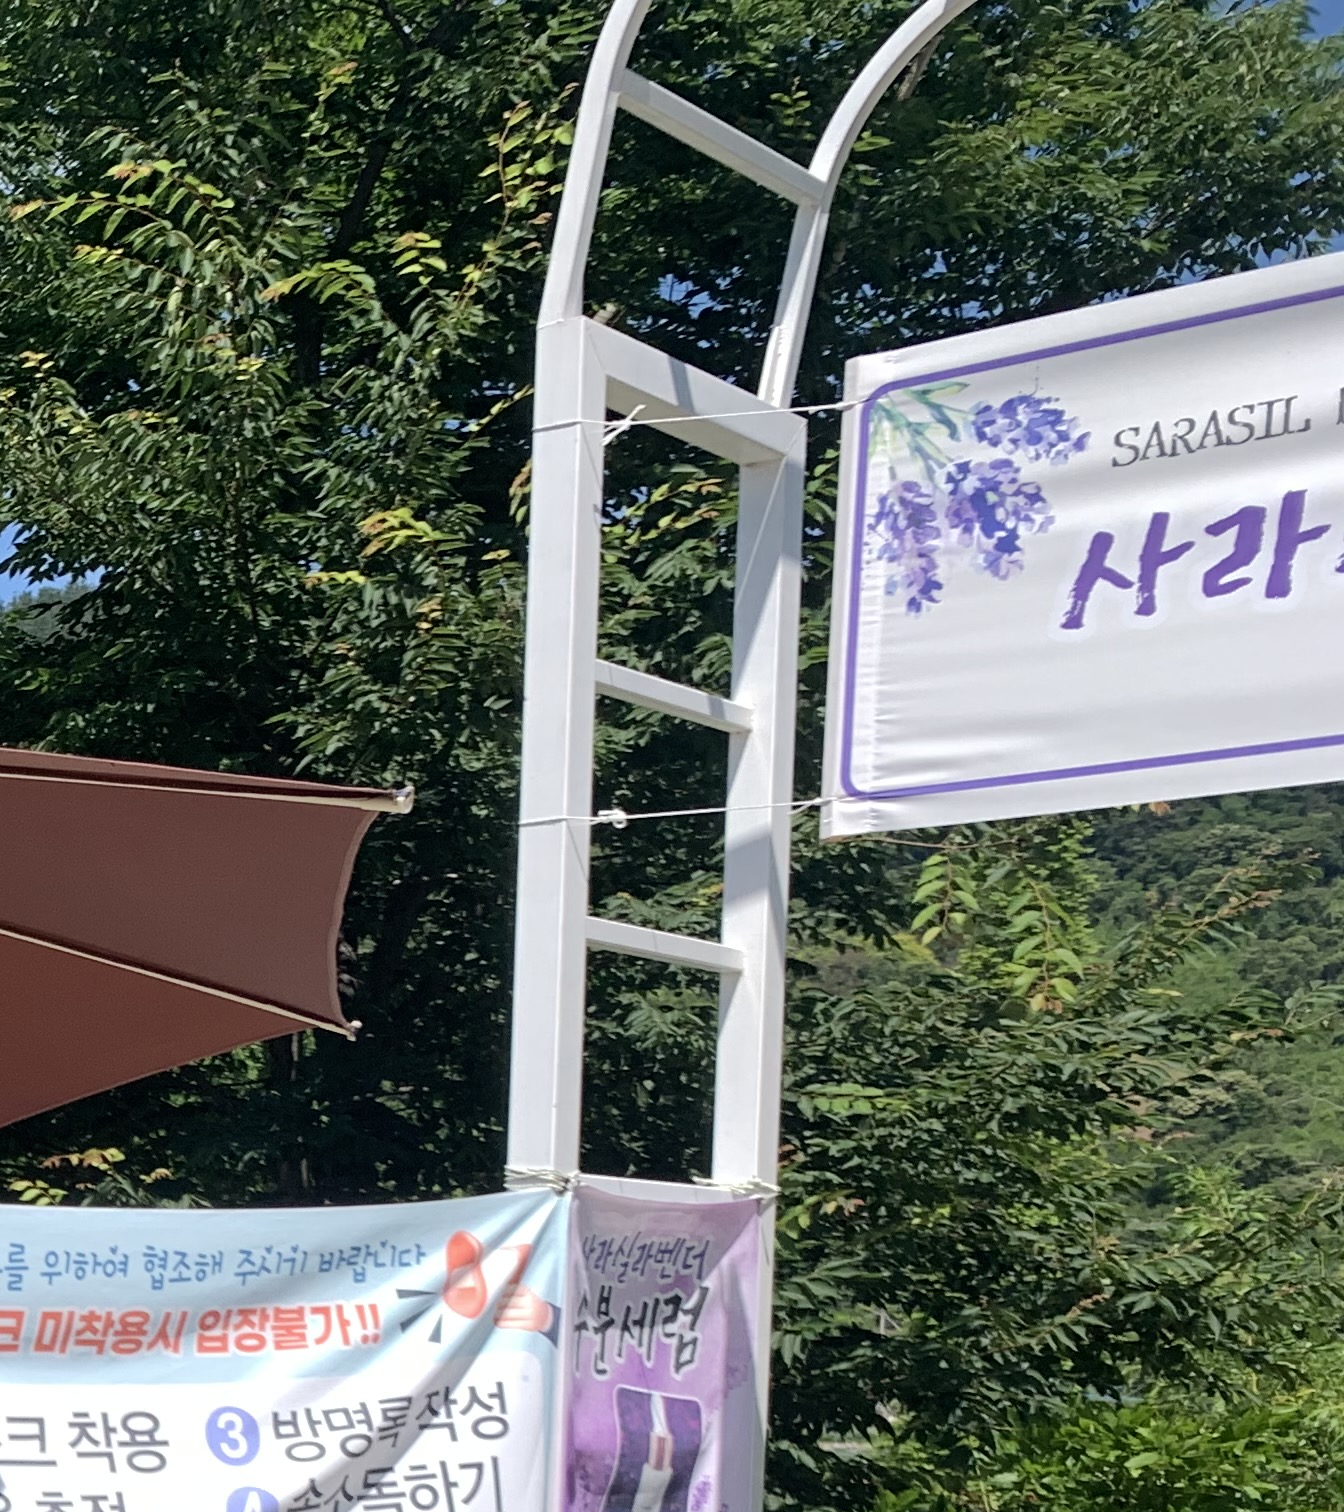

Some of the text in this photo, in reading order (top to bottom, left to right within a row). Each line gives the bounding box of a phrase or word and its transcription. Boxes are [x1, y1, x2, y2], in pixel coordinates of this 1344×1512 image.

[1112, 396, 1311, 468] SARASIL
[1060, 489, 1344, 631] 사라
[40, 1244, 129, 1285] 위하여
[142, 1245, 223, 1291] 협조해
[234, 1245, 307, 1286] 주시기
[318, 1240, 426, 1283] 바랍니다
[33, 1309, 188, 1355] 미착용시
[196, 1304, 382, 1354] 입장불가!!
[68, 1411, 170, 1474] 착용
[215, 1411, 249, 1460] 3
